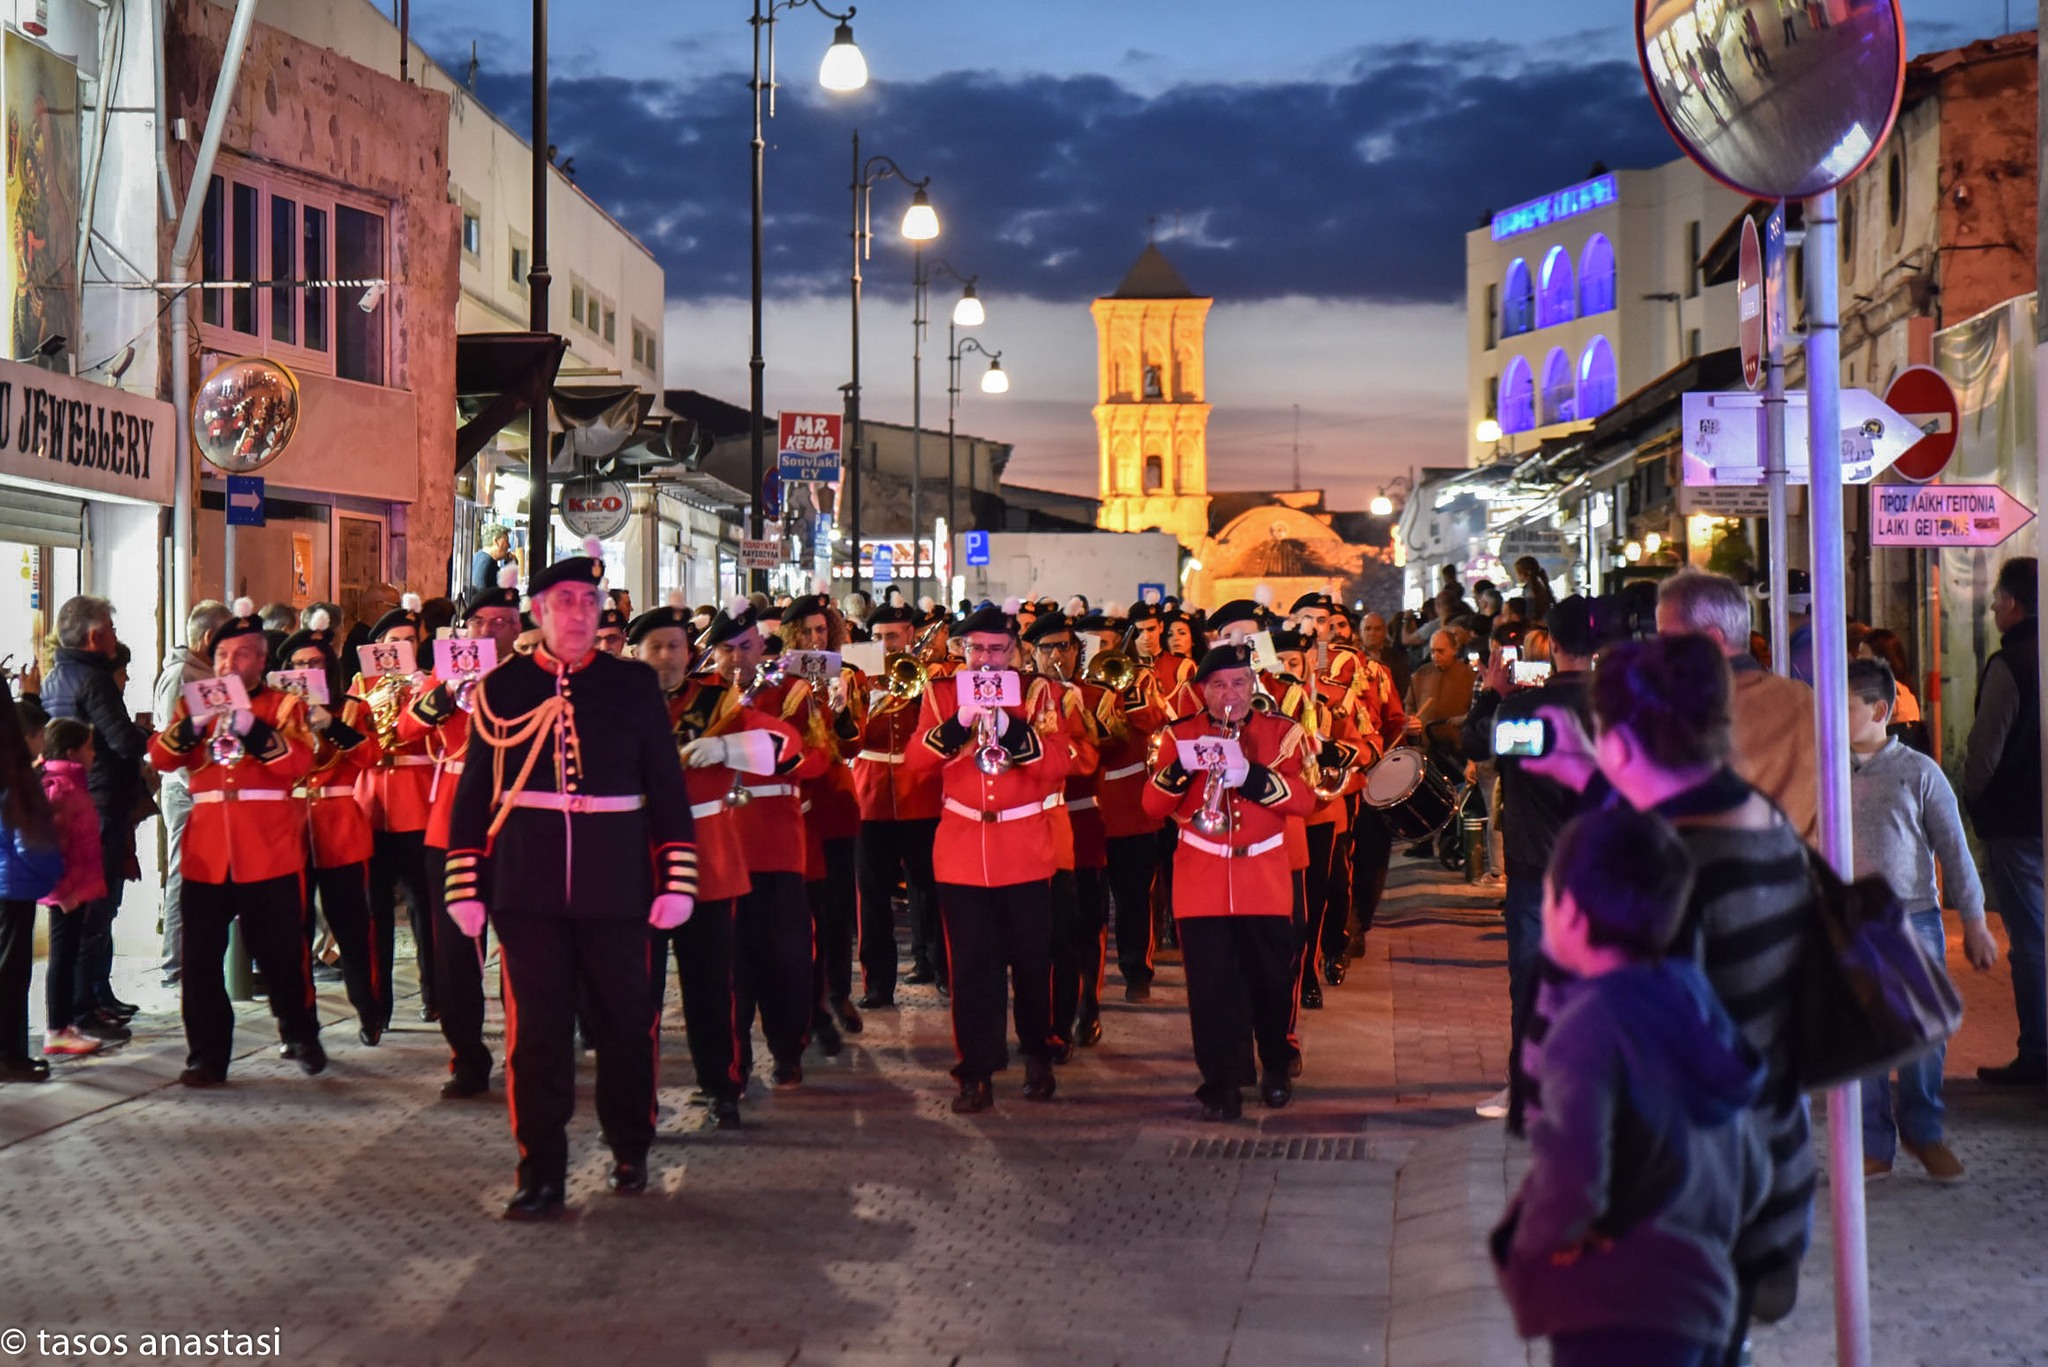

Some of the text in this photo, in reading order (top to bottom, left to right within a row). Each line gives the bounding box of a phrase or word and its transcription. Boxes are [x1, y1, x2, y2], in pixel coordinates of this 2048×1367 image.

[18, 386, 154, 479] JEWELLERY
[794, 415, 829, 435] MR.
[785, 434, 834, 451] KEBAB
[782, 454, 840, 468] Souvlaki
[1879, 492, 1996, 513] ΠΡΟΣ ΛΑΪΚΗ ΓΕΙΤΟΝΙΑ
[1879, 518, 1909, 536] LAIKI
[967, 533, 981, 554] P
